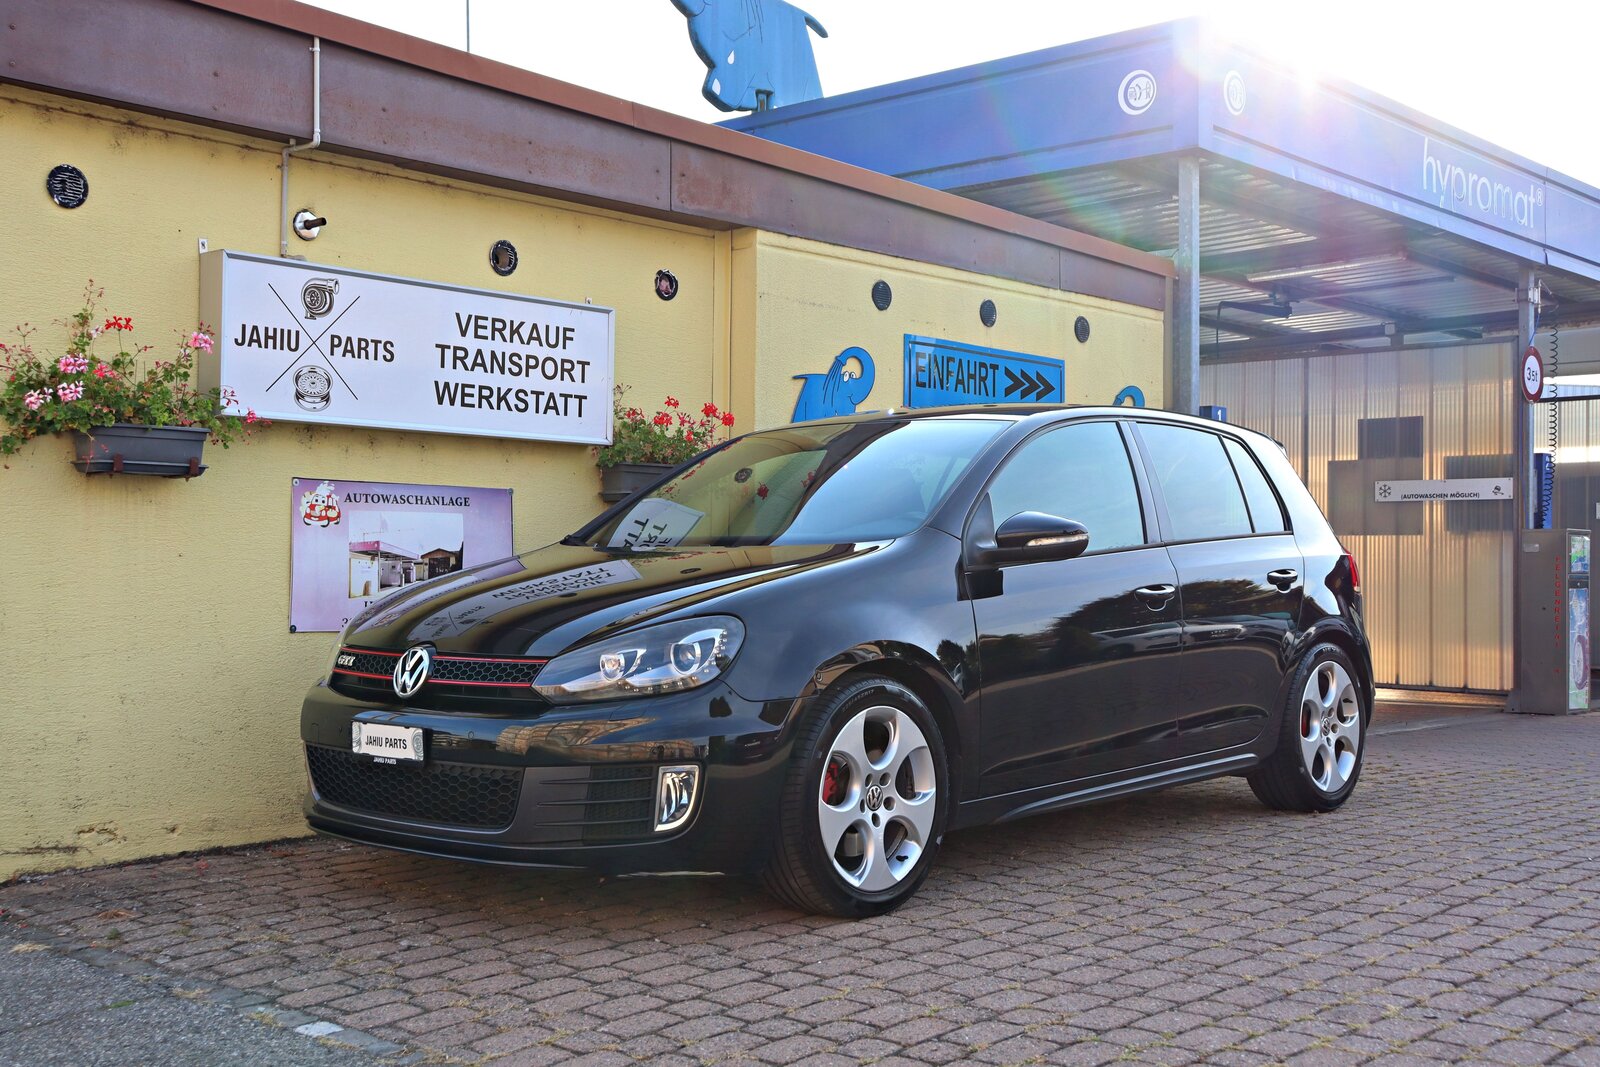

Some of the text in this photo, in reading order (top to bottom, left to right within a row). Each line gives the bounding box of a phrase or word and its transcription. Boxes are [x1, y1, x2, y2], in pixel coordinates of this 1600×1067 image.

[234, 323, 396, 364] JAHIU PARTS
[455, 312, 576, 350] VERKAUF
[435, 343, 591, 384] TRANSPORT
[915, 351, 1000, 398] EINFAHRT
[434, 380, 588, 418] WERKSTATT
[1217, 409, 1222, 421] 1
[343, 492, 471, 508] AUTOWASCHANLAGE
[365, 735, 408, 750] JAHIU PARTS
